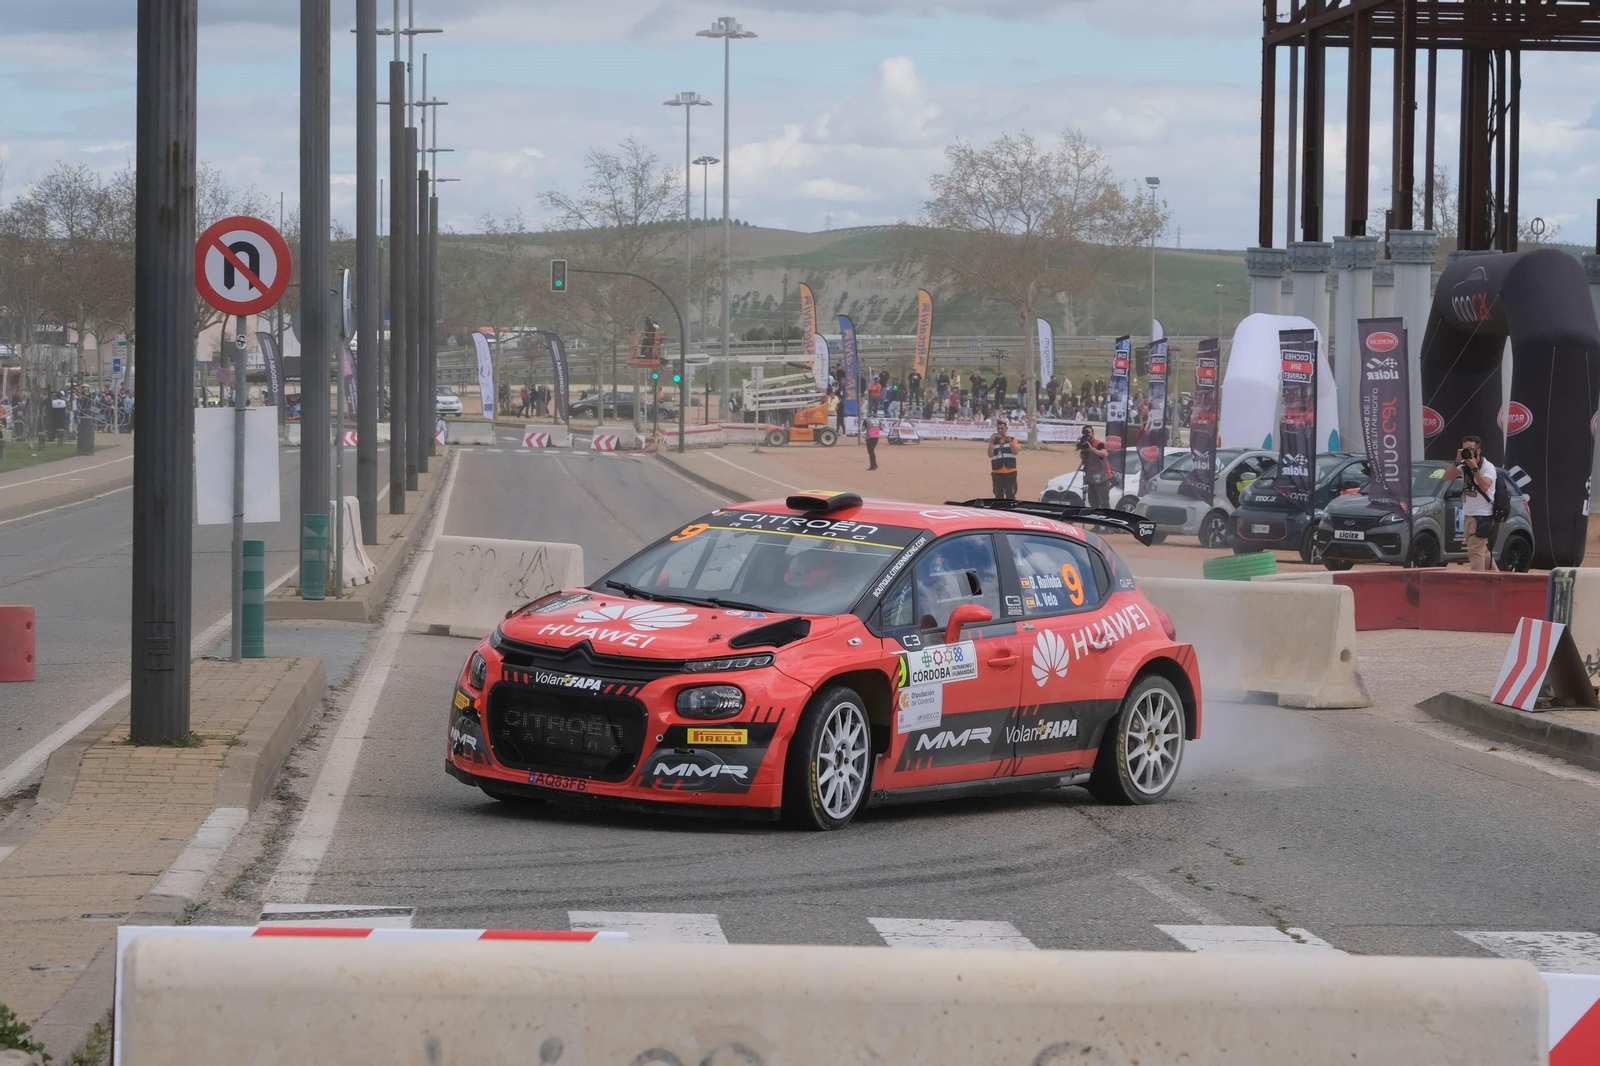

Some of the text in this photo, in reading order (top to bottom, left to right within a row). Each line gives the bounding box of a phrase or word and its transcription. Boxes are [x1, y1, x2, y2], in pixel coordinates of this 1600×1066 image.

[670, 523, 709, 542] 9
[1339, 531, 1359, 539] LIGIER
[1061, 563, 1084, 606] 9
[1041, 592, 1059, 607] Vela
[537, 623, 657, 649] HUAWEI
[902, 634, 922, 647] C3
[1070, 603, 1151, 661] HUAWEI
[912, 666, 951, 683] CÓRDOBA
[911, 690, 935, 700] Diputación
[693, 730, 743, 743] PIRELLI
[914, 726, 992, 752] MMR
[653, 762, 749, 779] MMR
